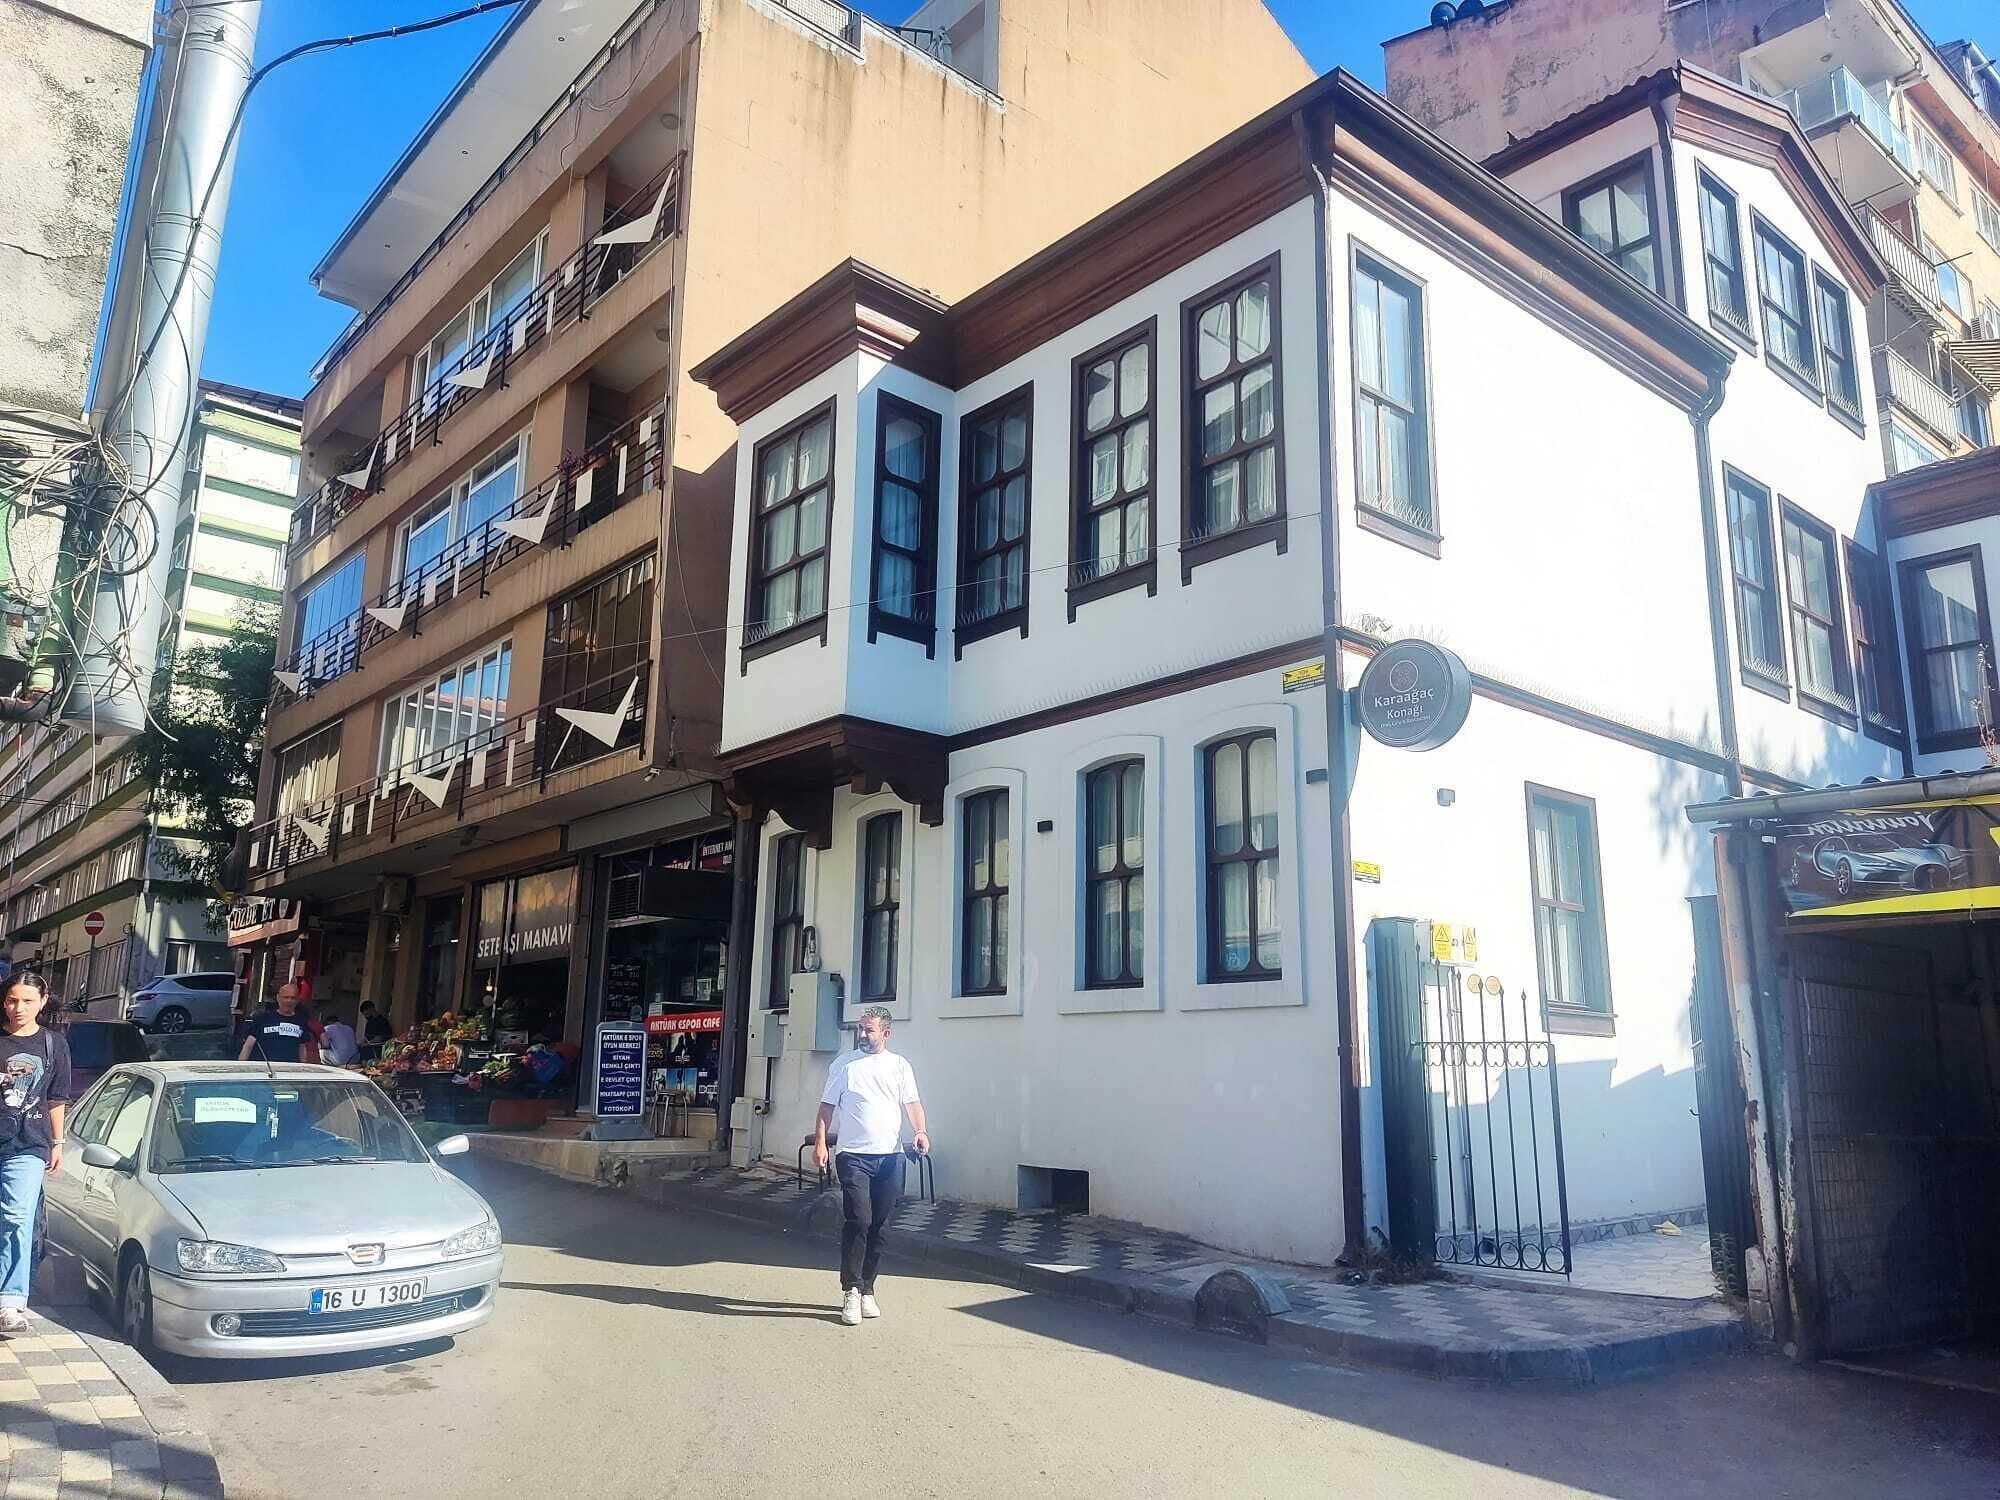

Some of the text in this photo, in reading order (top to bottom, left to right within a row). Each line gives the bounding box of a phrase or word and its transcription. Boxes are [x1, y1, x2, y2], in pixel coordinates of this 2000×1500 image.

[1374, 688, 1434, 708] Karaağaç
[1387, 703, 1424, 720] Konağı
[523, 923, 572, 951] MANAVI
[678, 1018, 702, 1030] ESPOR
[702, 1016, 721, 1029] CAFE
[324, 1291, 343, 1310] 16
[352, 1289, 366, 1307] U
[379, 1283, 421, 1304] 1300
